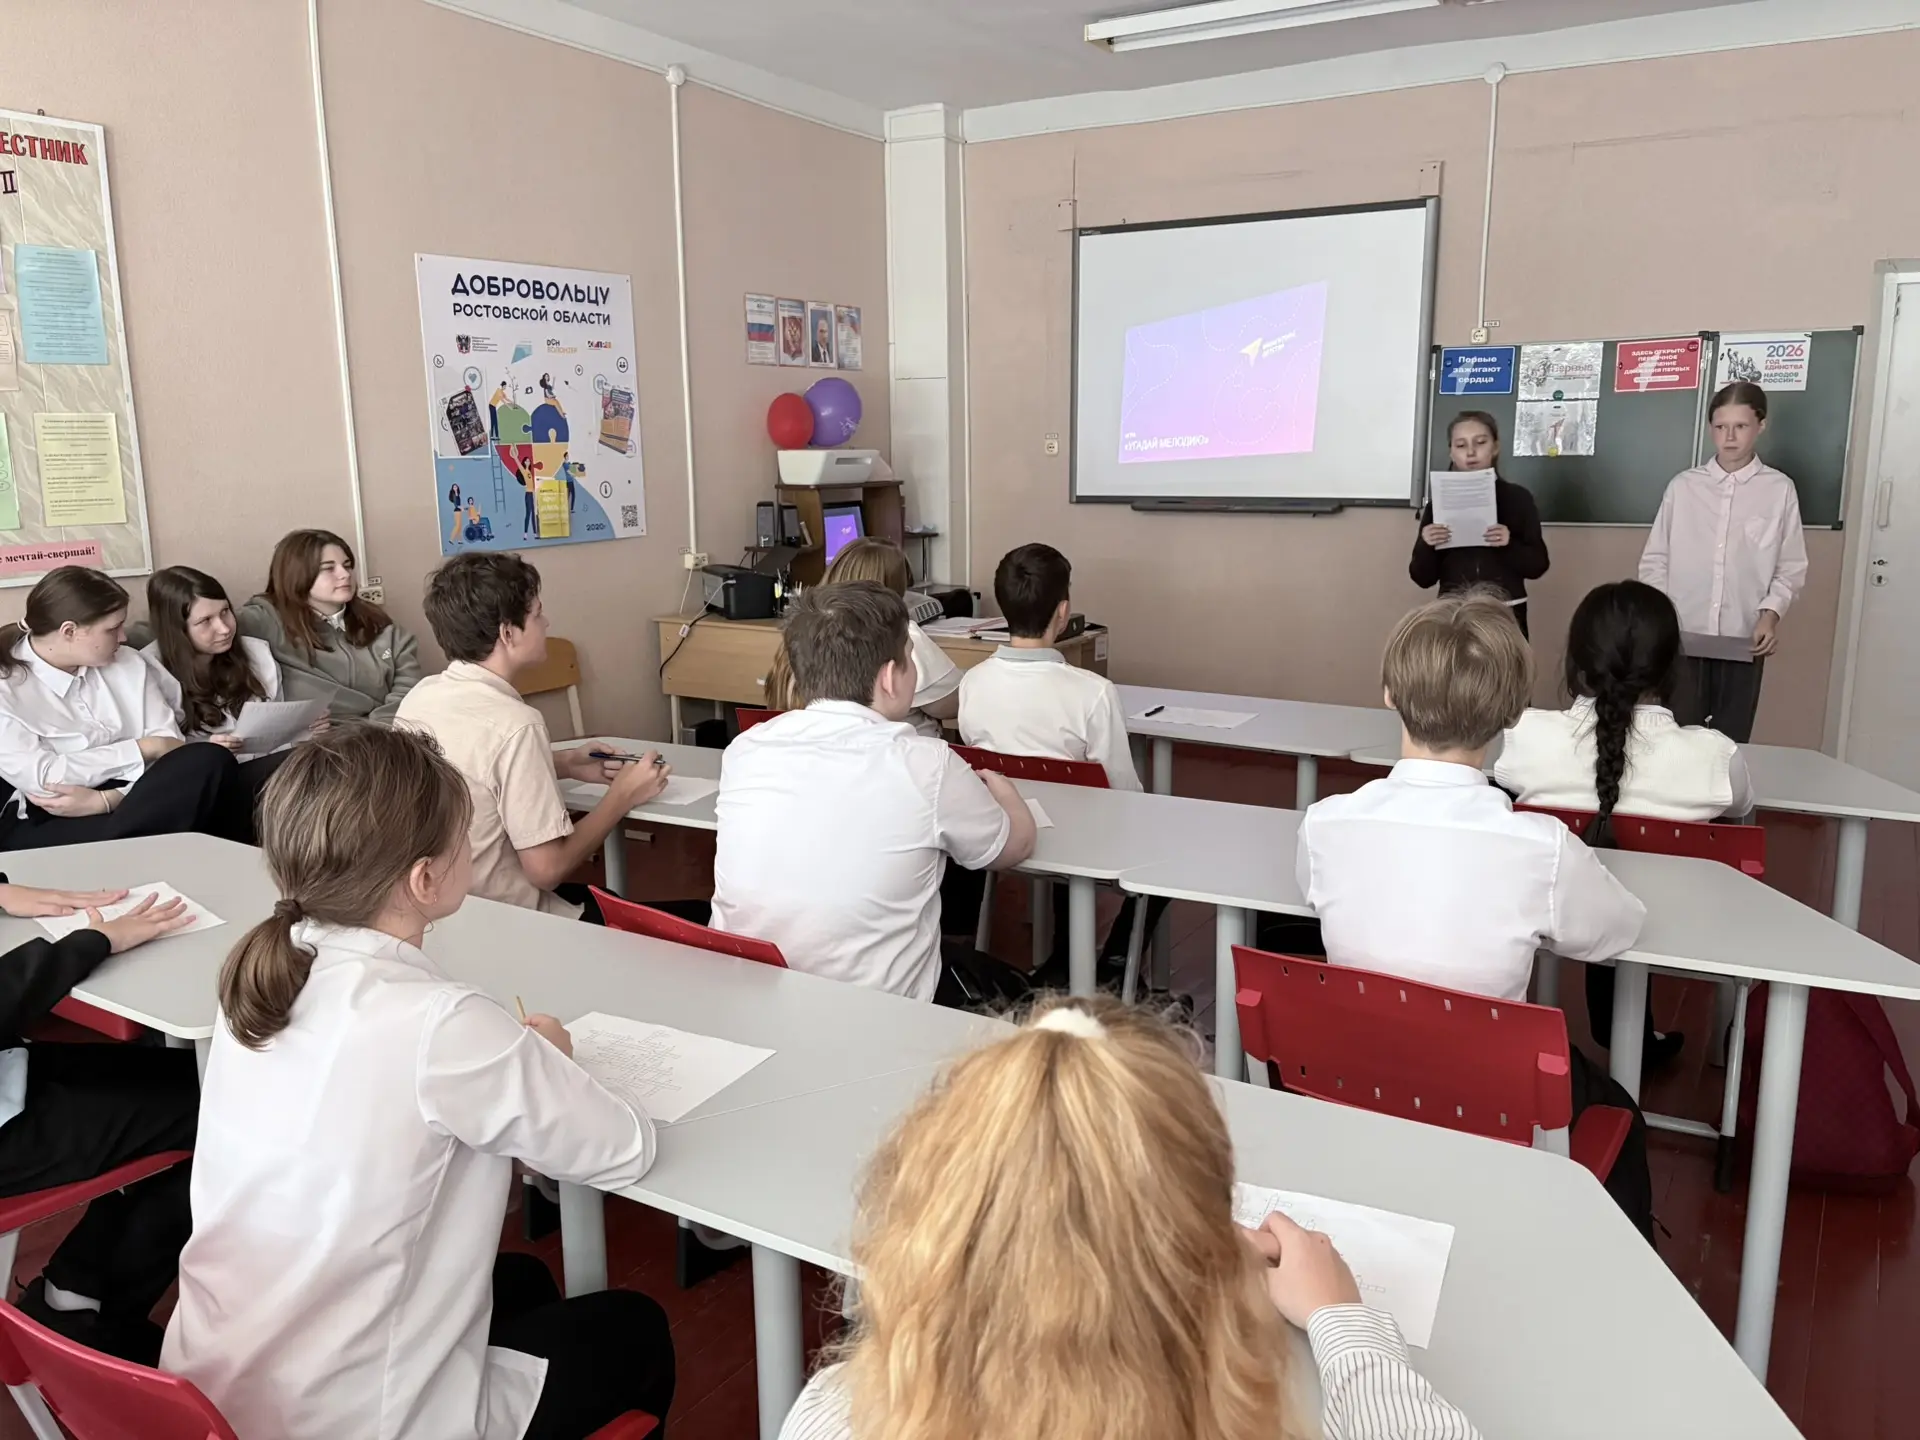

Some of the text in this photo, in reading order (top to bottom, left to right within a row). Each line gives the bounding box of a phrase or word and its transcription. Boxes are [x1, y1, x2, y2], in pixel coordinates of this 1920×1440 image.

[451, 273, 610, 306] ДОБРОВОЛЬЦУ
[453, 302, 611, 325] РОСТОВСКОЙ ОБЛАСТИ
[1766, 344, 1804, 358] 2026
[1458, 376, 1495, 384] сердца
[5, 545, 96, 563] мечтай-свершай!
